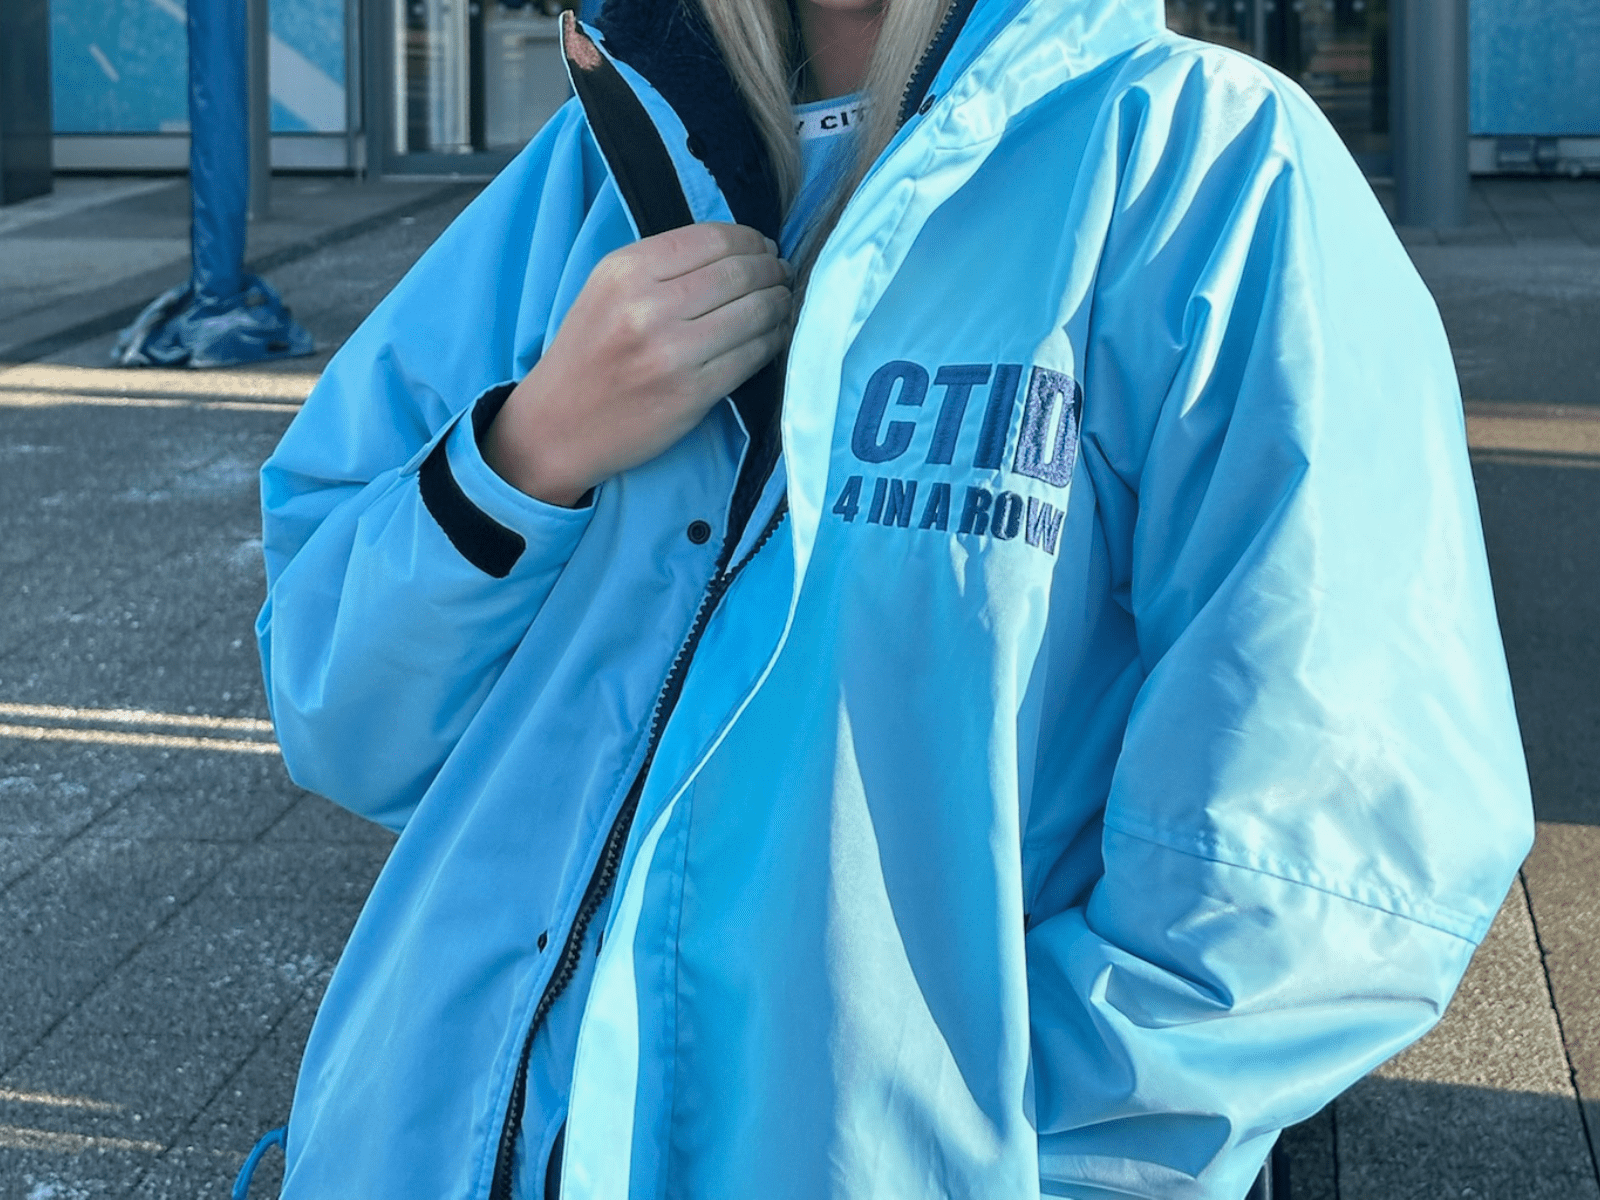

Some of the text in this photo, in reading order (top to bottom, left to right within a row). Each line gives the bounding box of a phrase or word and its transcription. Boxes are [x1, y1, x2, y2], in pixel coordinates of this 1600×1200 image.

[851, 360, 1083, 488] CTID
[832, 476, 1065, 556] 4 IN A ROW
